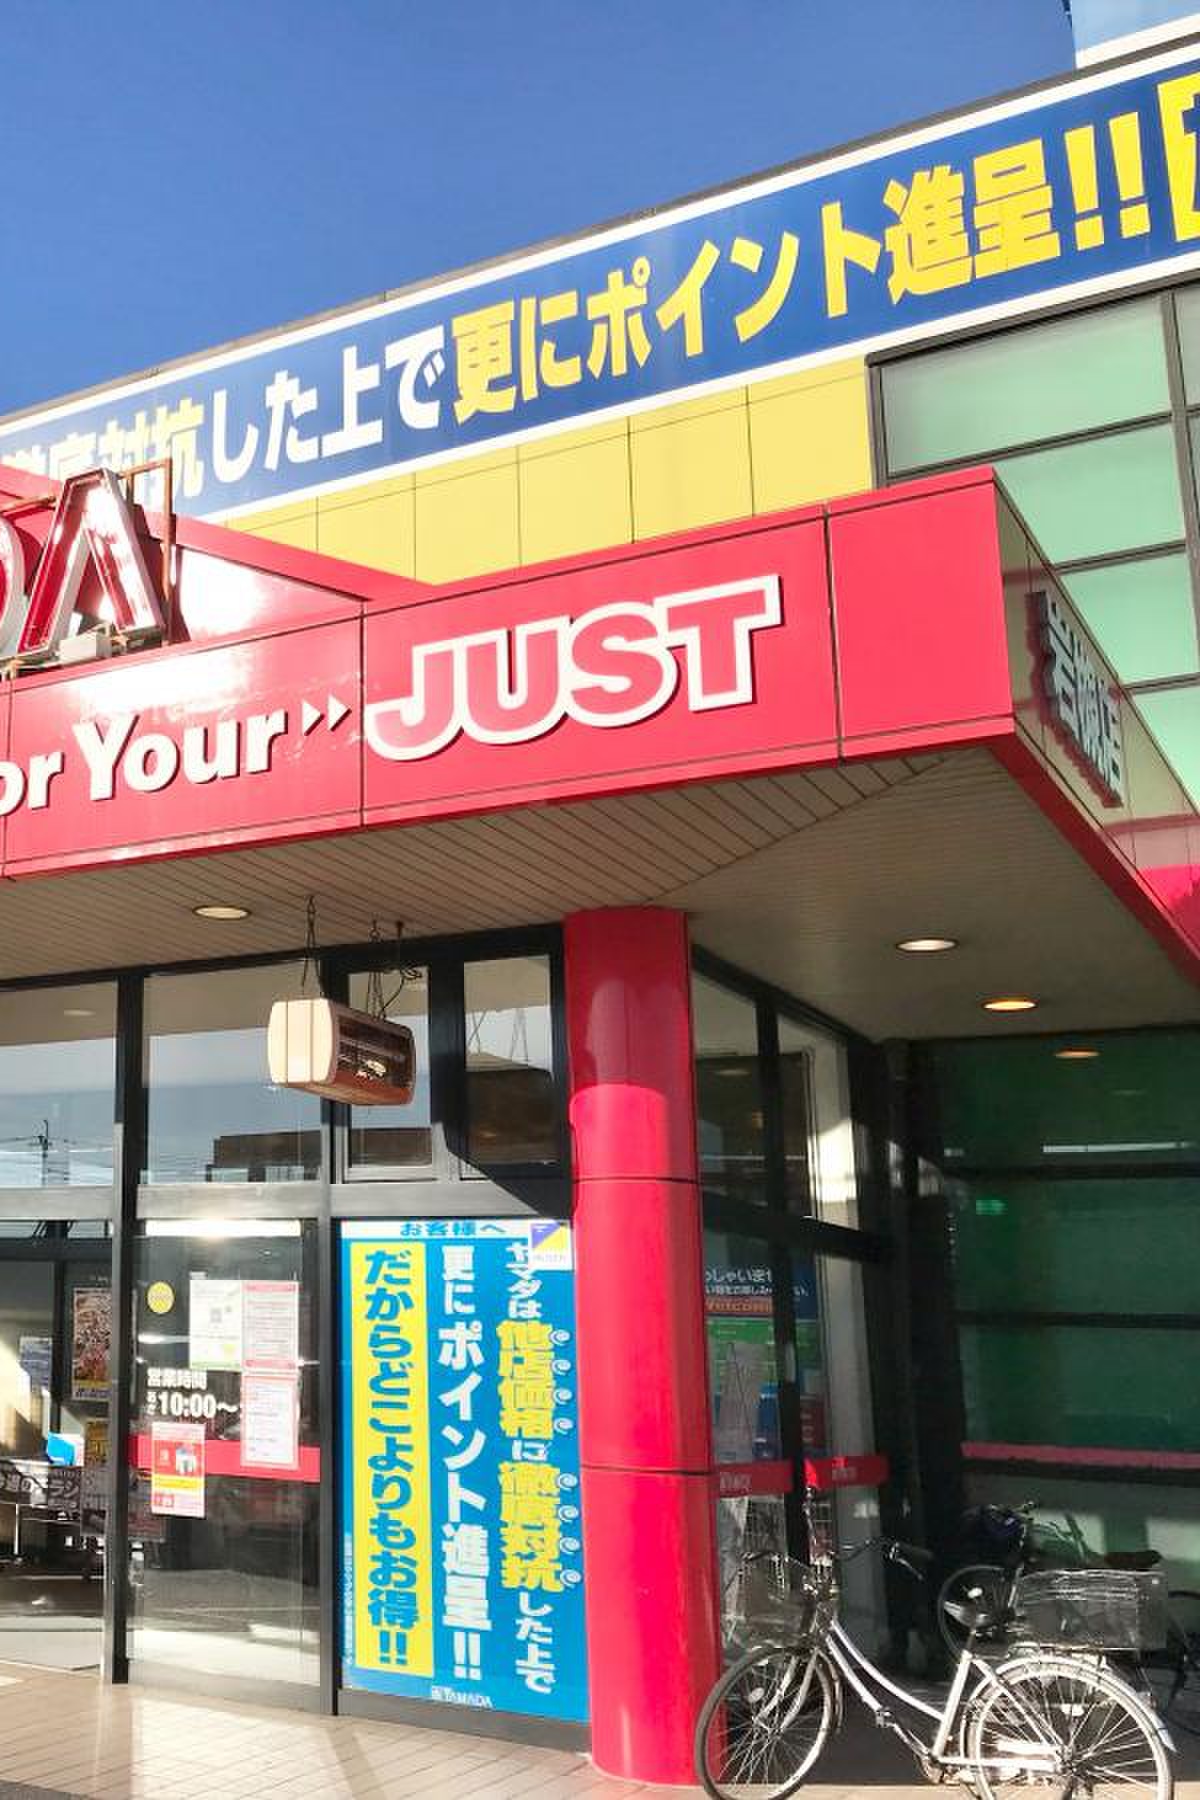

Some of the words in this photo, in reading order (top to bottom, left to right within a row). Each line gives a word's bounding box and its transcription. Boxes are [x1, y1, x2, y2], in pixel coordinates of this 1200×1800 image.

[1, 111, 1150, 513] 対抗した上で更にポイント進呈!!
[74, 708, 288, 801] Your
[363, 573, 785, 762] JUST
[365, 1248, 421, 1667] だからどこよりもお得!!
[438, 1244, 492, 1682] 更にポイント進呈!!
